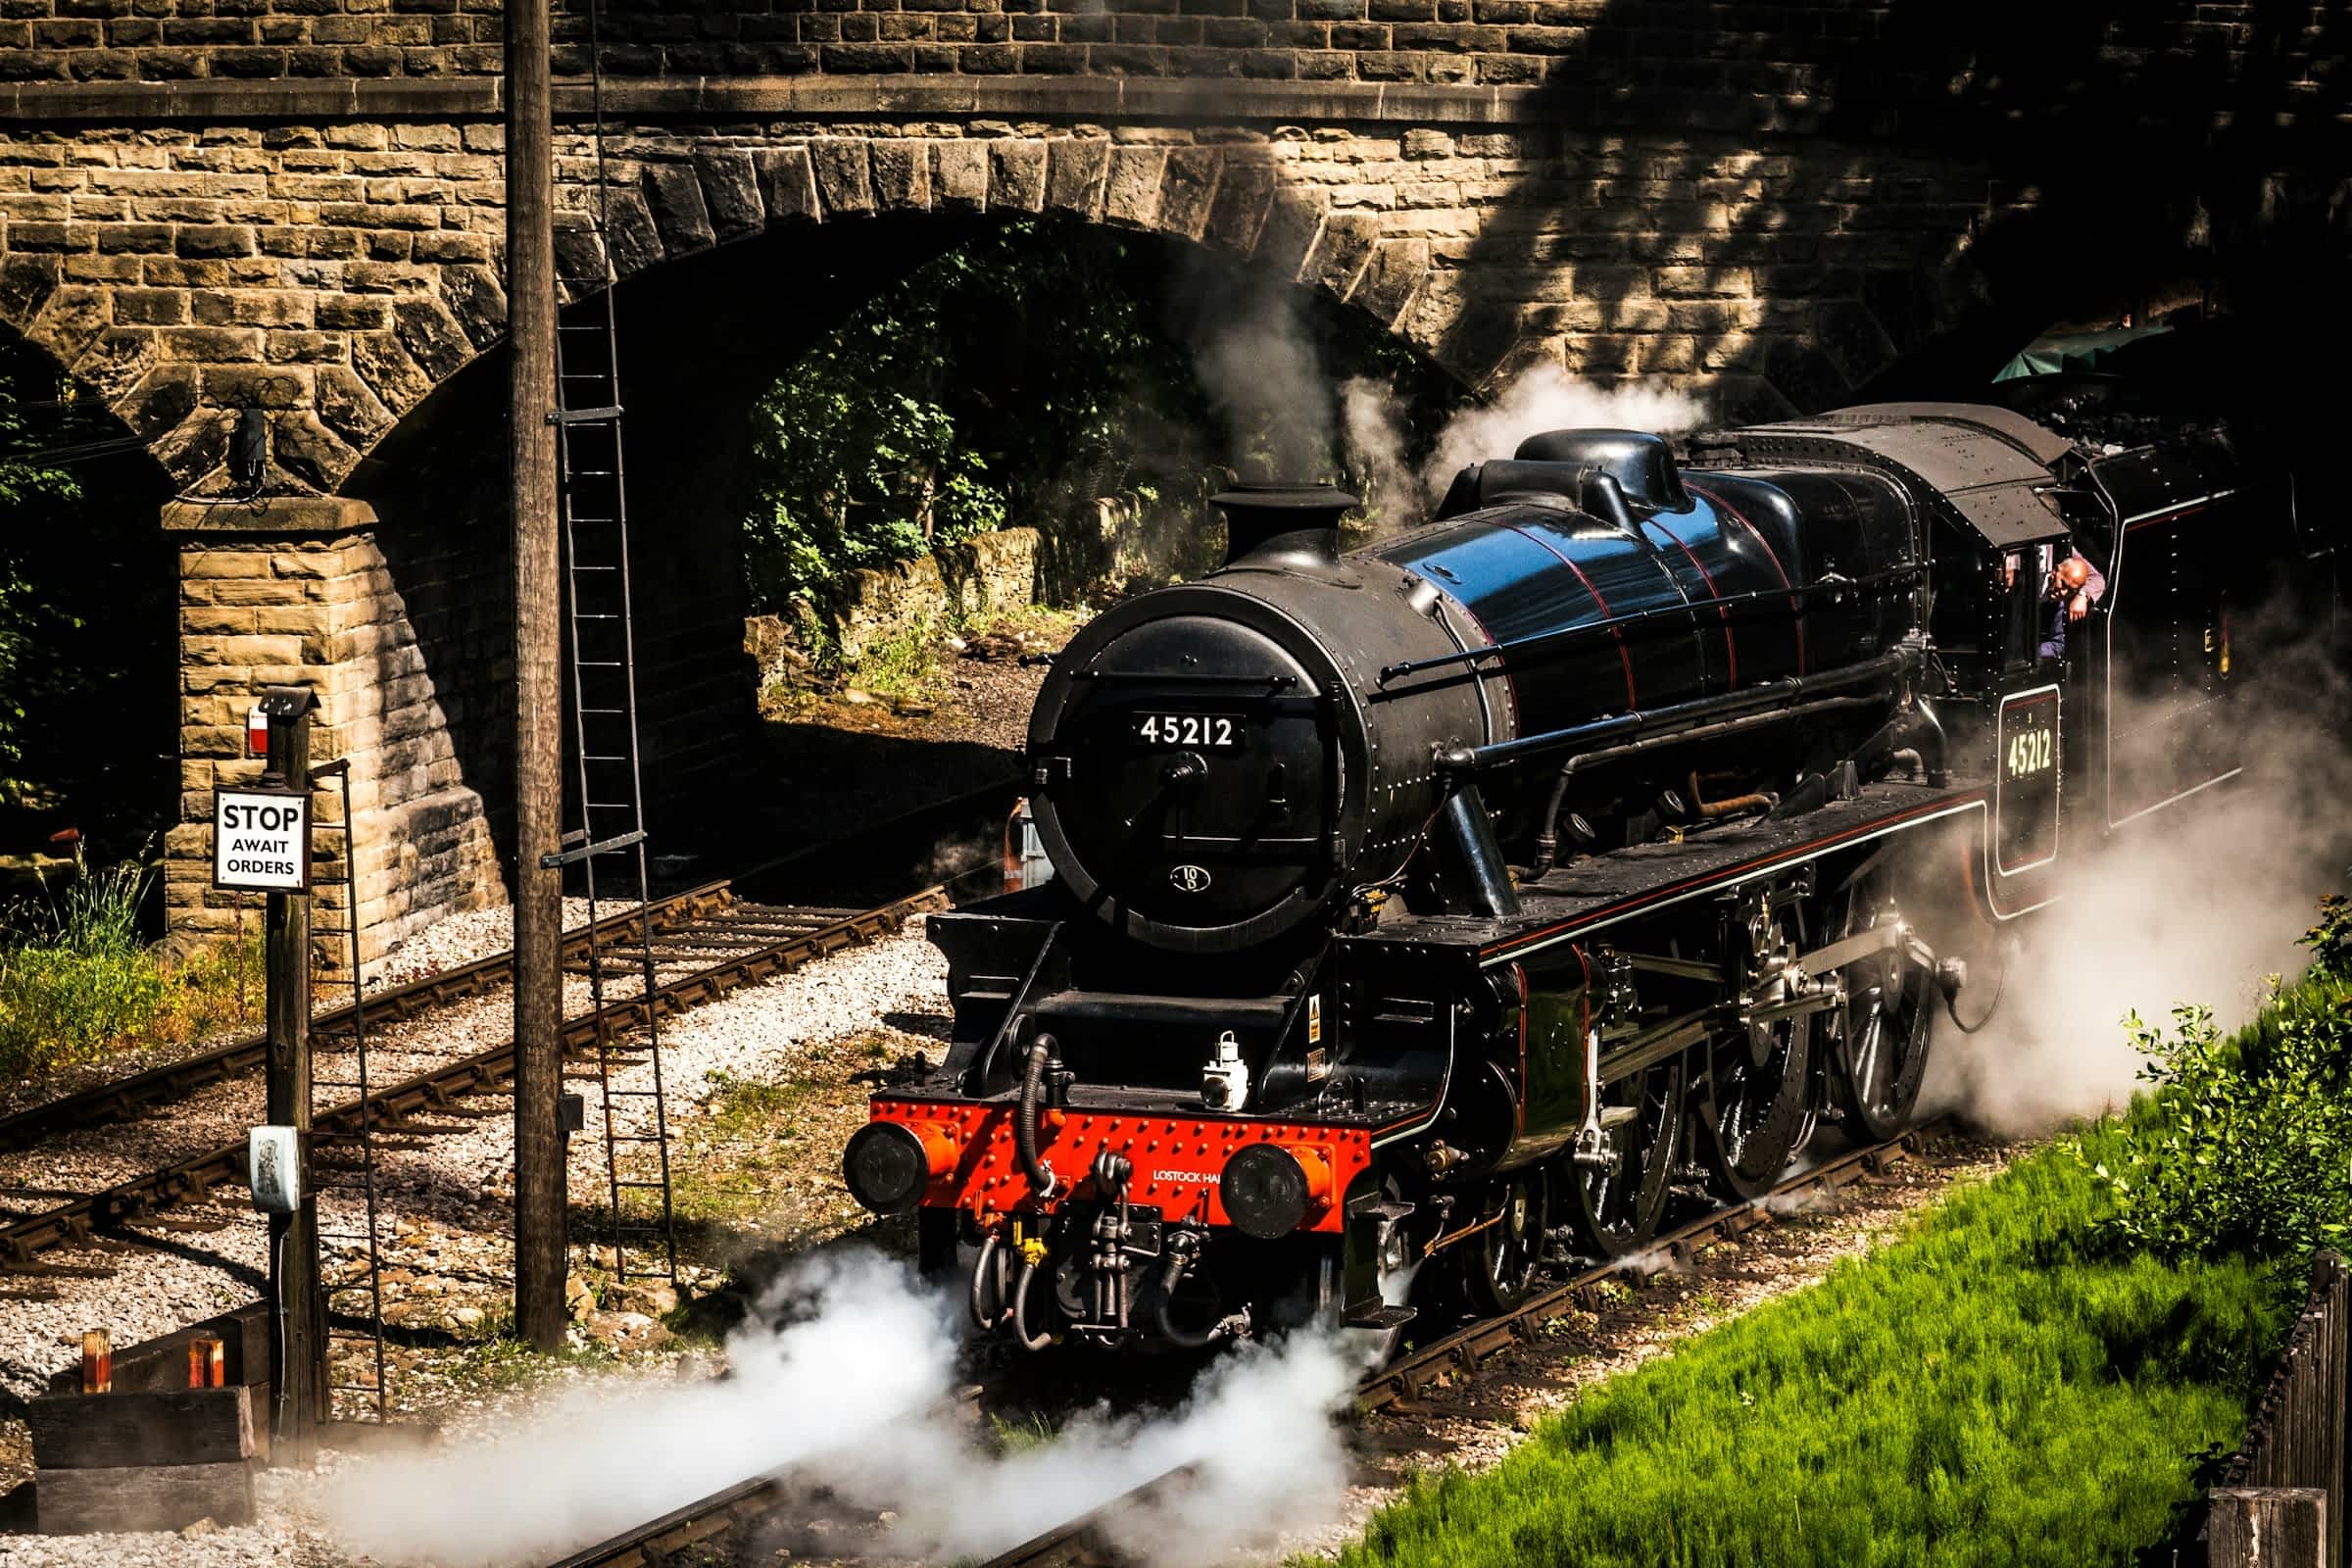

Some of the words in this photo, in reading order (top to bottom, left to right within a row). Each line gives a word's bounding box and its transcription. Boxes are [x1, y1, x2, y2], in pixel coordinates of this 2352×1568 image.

[1140, 715, 1233, 745] 45212
[2008, 728, 2051, 777] 45212
[223, 804, 299, 832] STOP
[231, 838, 289, 854] AWAIT
[227, 858, 295, 875] ORDERS
[1152, 1169, 1201, 1183] LOSTOCK
